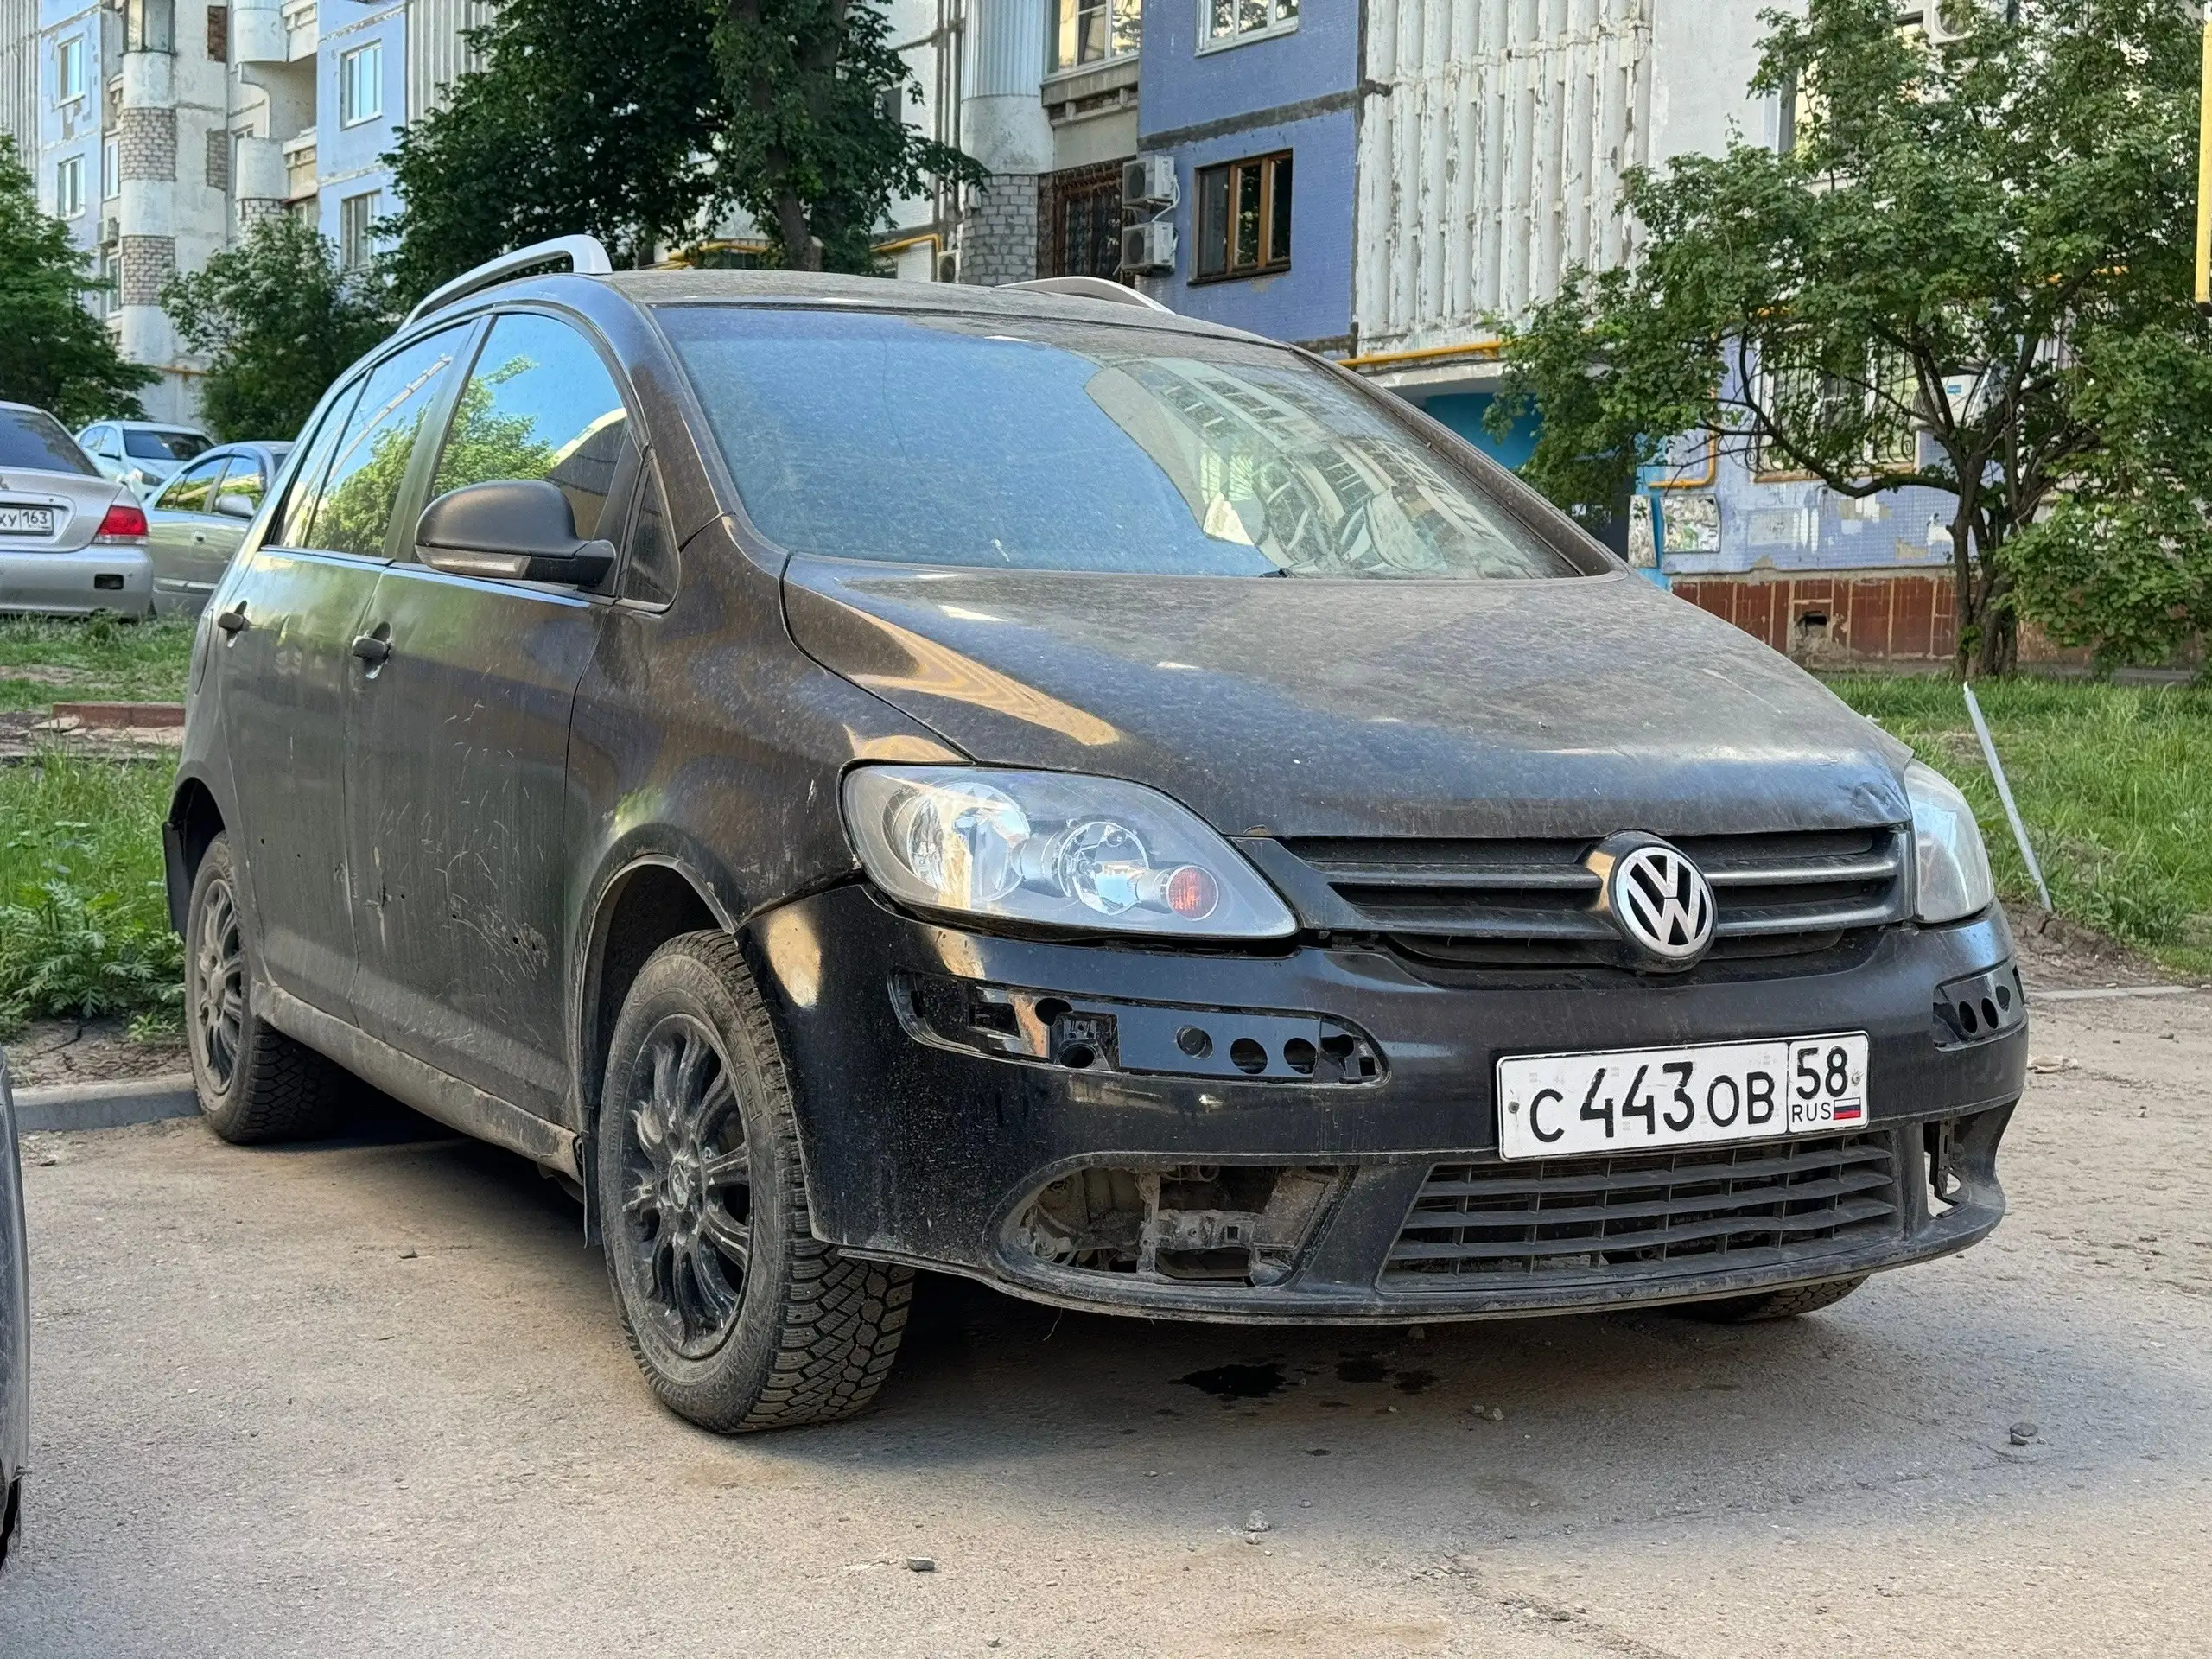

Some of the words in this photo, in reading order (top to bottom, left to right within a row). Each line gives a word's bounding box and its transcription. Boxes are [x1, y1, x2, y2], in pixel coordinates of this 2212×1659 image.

[22, 511, 48, 524] 163
[1796, 1046, 1848, 1100] 58
[1791, 1102, 1833, 1122] RUS
